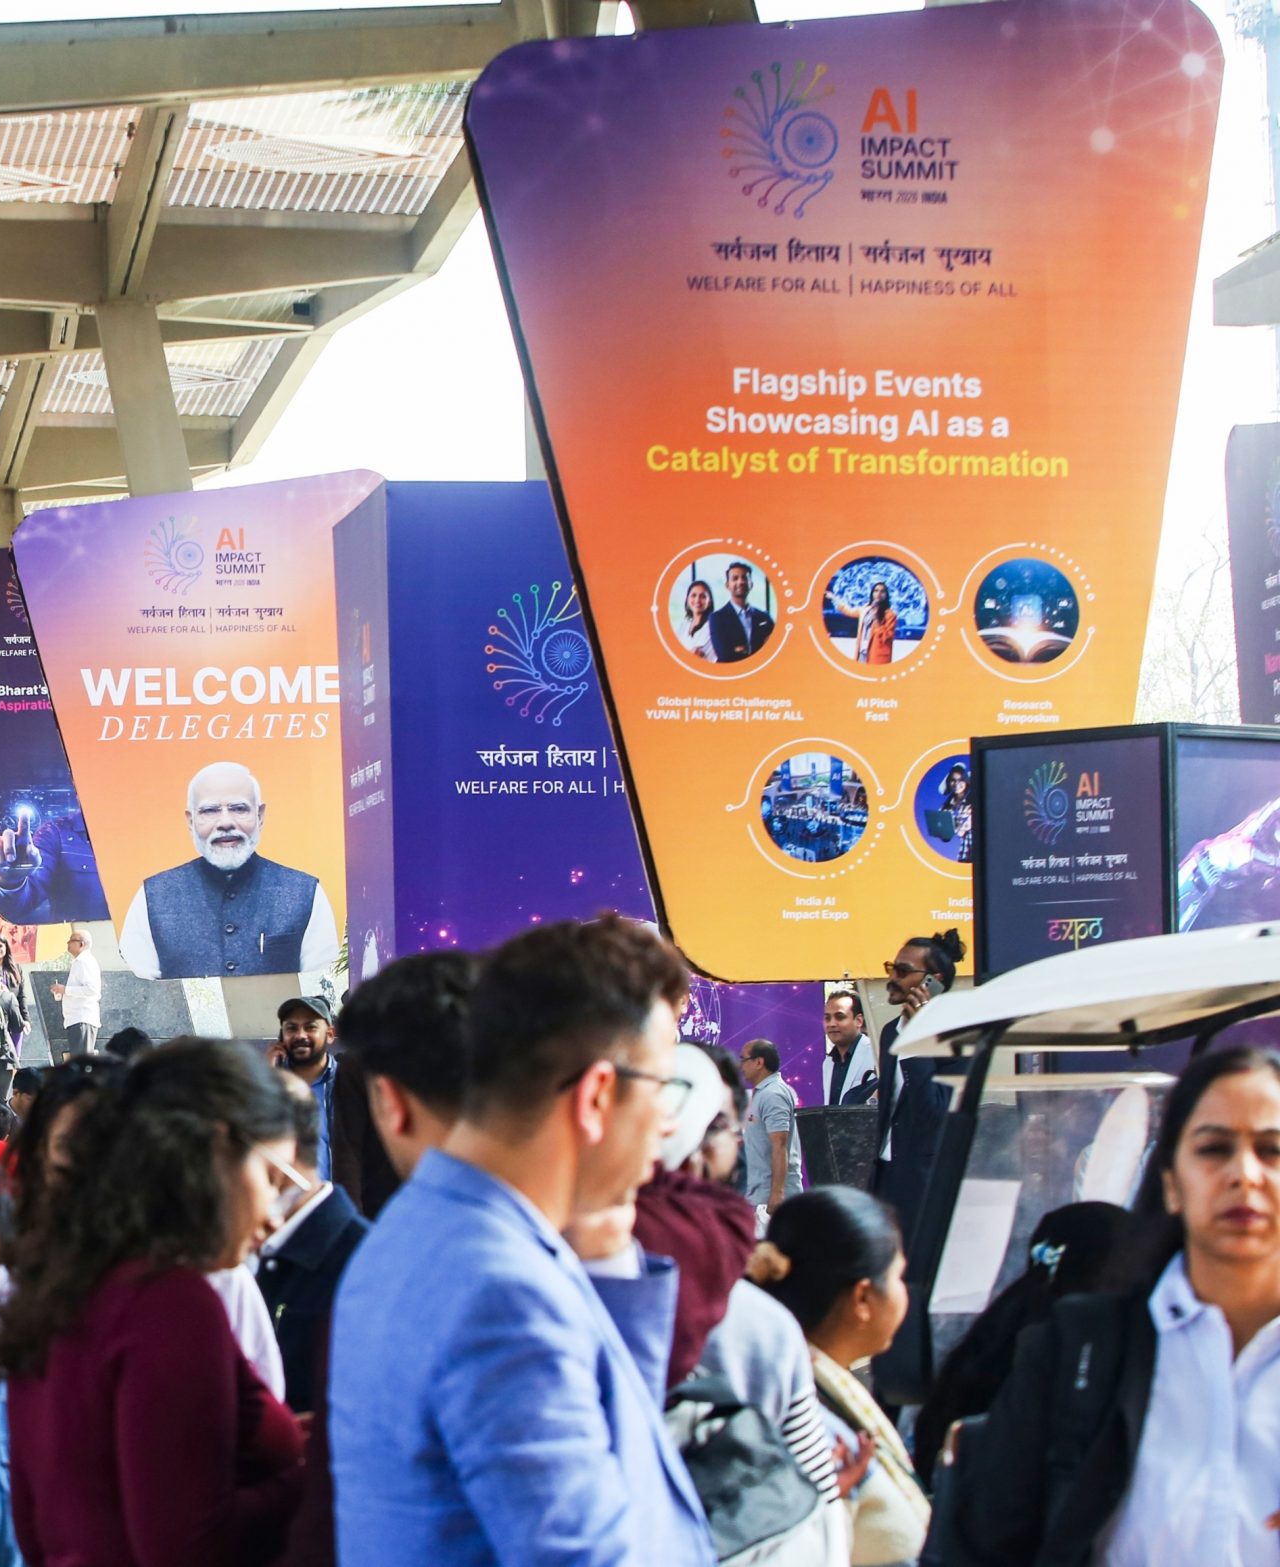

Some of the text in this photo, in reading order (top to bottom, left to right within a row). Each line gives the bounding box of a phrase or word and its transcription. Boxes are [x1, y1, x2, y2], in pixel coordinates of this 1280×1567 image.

[861, 87, 918, 134] AI
[861, 137, 951, 158] IMPACT
[861, 159, 959, 181] SUMMIT
[711, 237, 992, 272] सर्वजन हिताय सर्वजन सुखाय
[686, 276, 1019, 298] WELFARE FOR ALL HAPPINESS OF ALL
[733, 367, 983, 403] Flagship Events
[705, 406, 1010, 443] Showcasing AI as a
[646, 444, 1070, 479] Catalyst of Transformation
[216, 527, 245, 551] AI
[215, 552, 262, 563] IMPACT
[215, 563, 266, 575] SUMMIT
[140, 604, 284, 620] सर्वजन हिताय सर्वजन सुखाय
[127, 623, 297, 634] WELFARE FOR ALL HAPPINESS OF ALL
[3, 634, 32, 645] सर्वजन
[80, 666, 340, 707] WELCOME
[657, 696, 793, 709] Global Impact Challenges
[856, 697, 898, 709] AI Pitch
[1003, 699, 1053, 711] Research
[691, 709, 703, 720] AI
[704, 709, 718, 722] by
[721, 710, 743, 720] HER
[752, 710, 764, 720] AI
[765, 710, 780, 720] for
[783, 710, 804, 721] ALL
[865, 711, 889, 722] Fest
[997, 712, 1060, 725] Symposium
[98, 712, 330, 742] DELEGATES
[476, 744, 539, 768] सर्वजन
[545, 744, 597, 768] हिताय
[455, 780, 528, 795] WELFARE
[532, 780, 564, 794] FOR
[568, 780, 597, 794] ALL
[1076, 772, 1099, 797] AI
[1076, 797, 1111, 809] IMPACT
[1076, 809, 1114, 822] SUMMIT
[1012, 870, 1138, 886] WELFARE FOR ALL HAPPINESS OF ALL
[795, 896, 836, 907] India AI
[782, 909, 849, 922] Impact Expo
